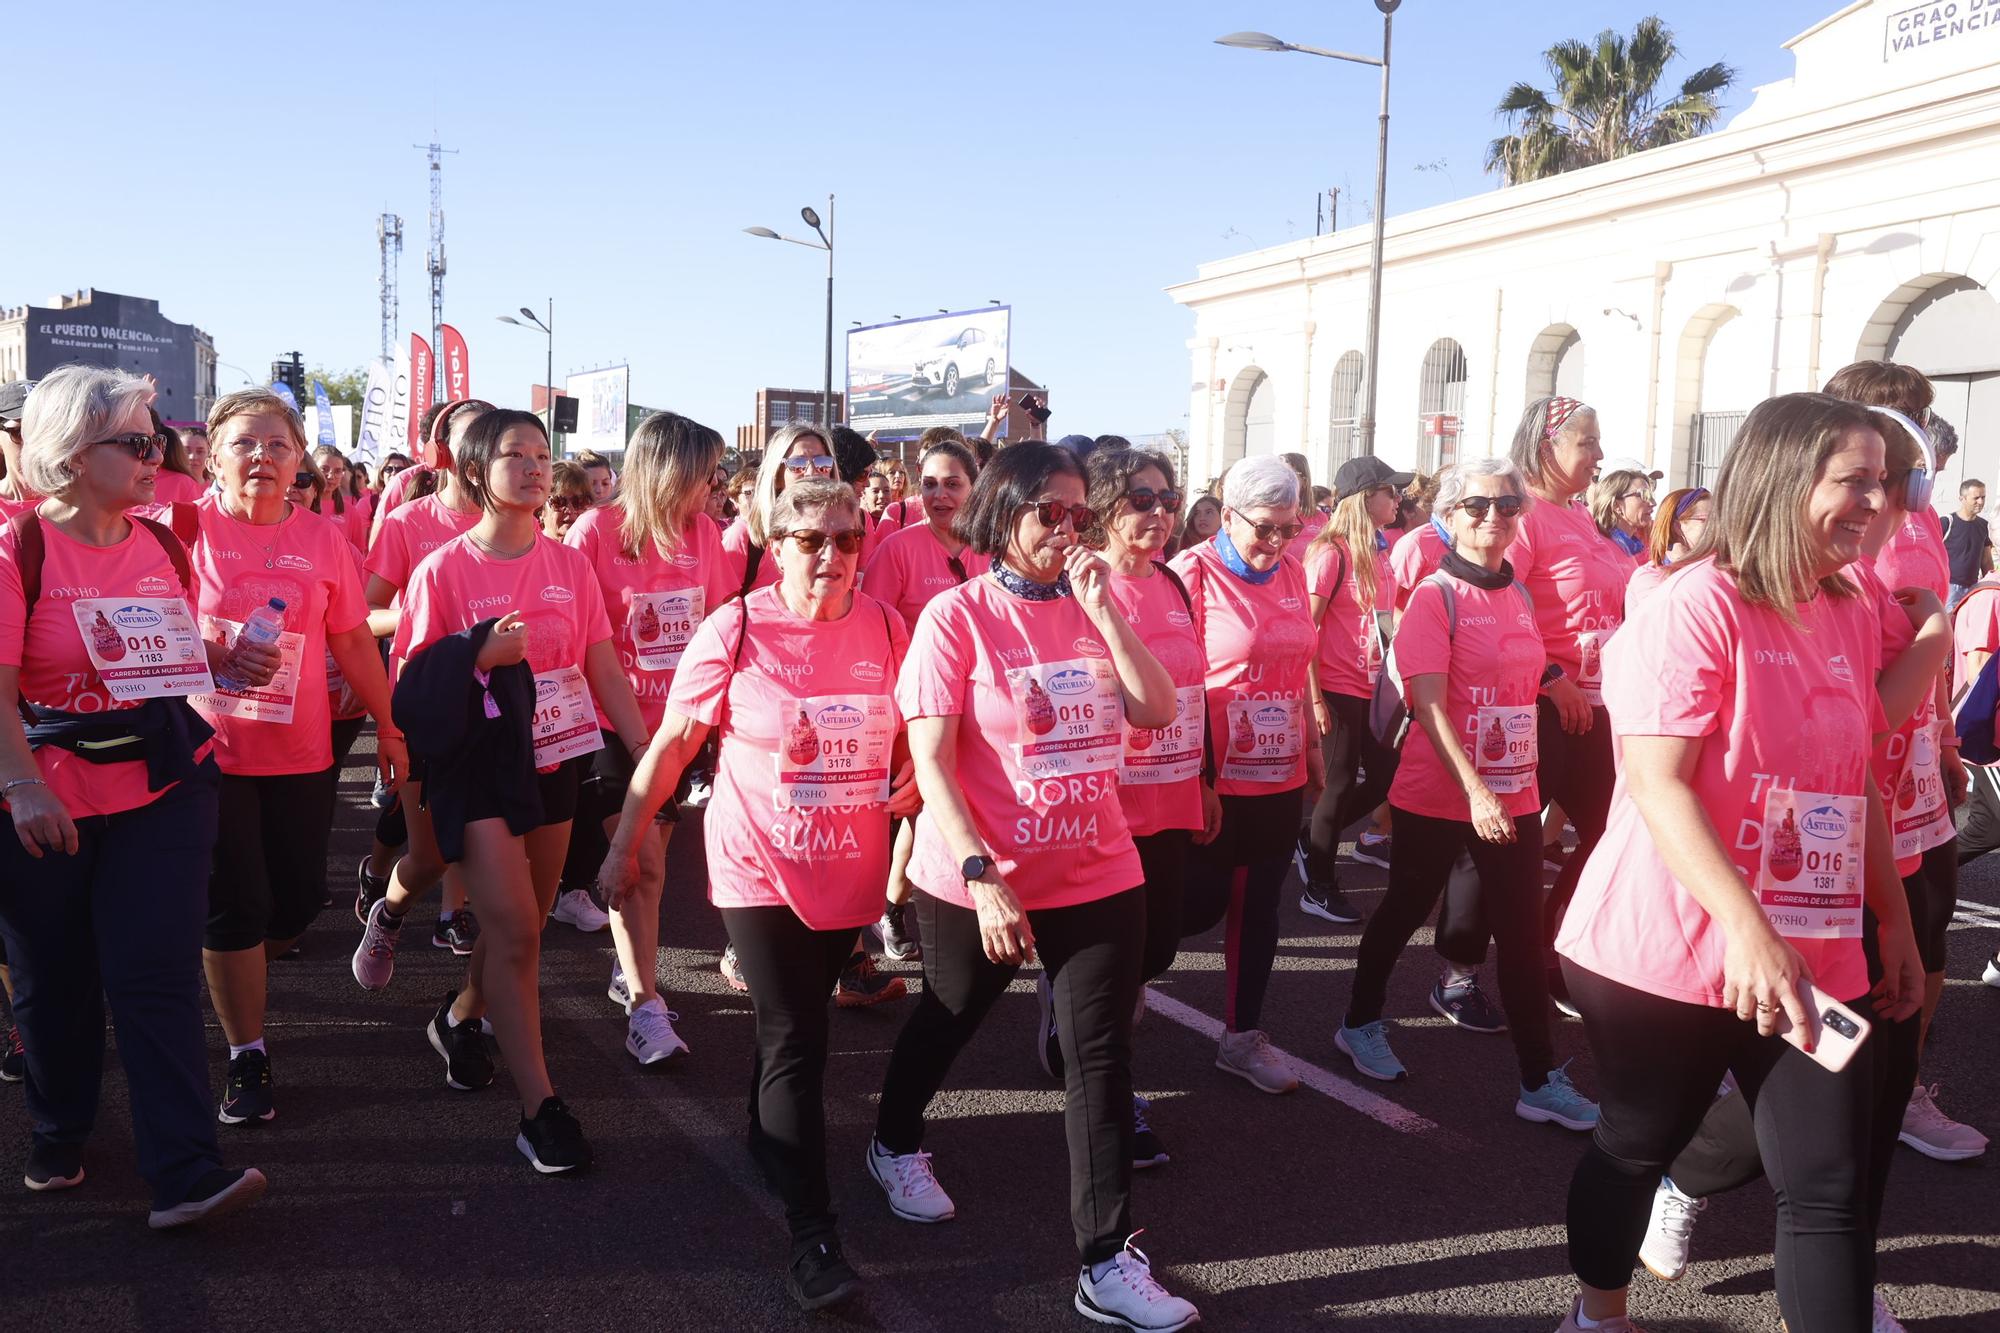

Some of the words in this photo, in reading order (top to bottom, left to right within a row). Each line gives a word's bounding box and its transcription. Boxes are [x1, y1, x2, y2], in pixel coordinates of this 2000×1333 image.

[1898, 3, 1957, 32] GRAO
[1892, 7, 2000, 52] VALENCIA
[40, 325, 53, 334] EL
[55, 324, 99, 339] PUERTO
[51, 338, 114, 350] Restaurante
[924, 576, 956, 585] OYSHO
[468, 594, 512, 609] OYSHO
[117, 614, 160, 624] ASTURIANA
[1459, 615, 1497, 627] OYSHO
[662, 620, 690, 634] 016
[127, 636, 167, 650] 016
[668, 634, 685, 642] 1366
[139, 652, 163, 663] 1183
[762, 664, 814, 676] OYSHO
[112, 684, 146, 694] OYSHO
[172, 680, 204, 688] Santander
[1051, 681, 1092, 690] ASTURIANA
[194, 695, 227, 708] OYSHO
[1468, 686, 1496, 706] TU
[253, 706, 285, 716] Santander
[532, 705, 562, 724] 016
[1060, 704, 1094, 721] 016
[820, 714, 860, 724] ASTURIANA
[541, 723, 556, 734] 497
[1068, 724, 1090, 736] 3181
[1156, 726, 1182, 740] 016
[540, 738, 548, 746] DE
[550, 735, 558, 743] LA
[565, 738, 594, 752] Santander
[1258, 733, 1285, 746] 016
[822, 738, 858, 755] 016
[1035, 744, 1068, 752] CARRERA
[1262, 747, 1280, 755] 3179
[1509, 740, 1529, 754] 016
[828, 758, 852, 768] 3178
[1034, 758, 1070, 770] OYSHO
[793, 774, 826, 782] CARRERA
[1230, 768, 1258, 776] OYSHO
[1016, 773, 1114, 806] DORSA
[1918, 773, 1936, 794] 016
[790, 790, 826, 798] OYSHO
[1014, 812, 1098, 844] SUMA
[770, 824, 858, 851] SUMA
[1806, 850, 1843, 871] 016
[1814, 876, 1834, 889] 1381
[1774, 894, 1808, 904] CARRERA
[1769, 914, 1808, 926] OYSHO
